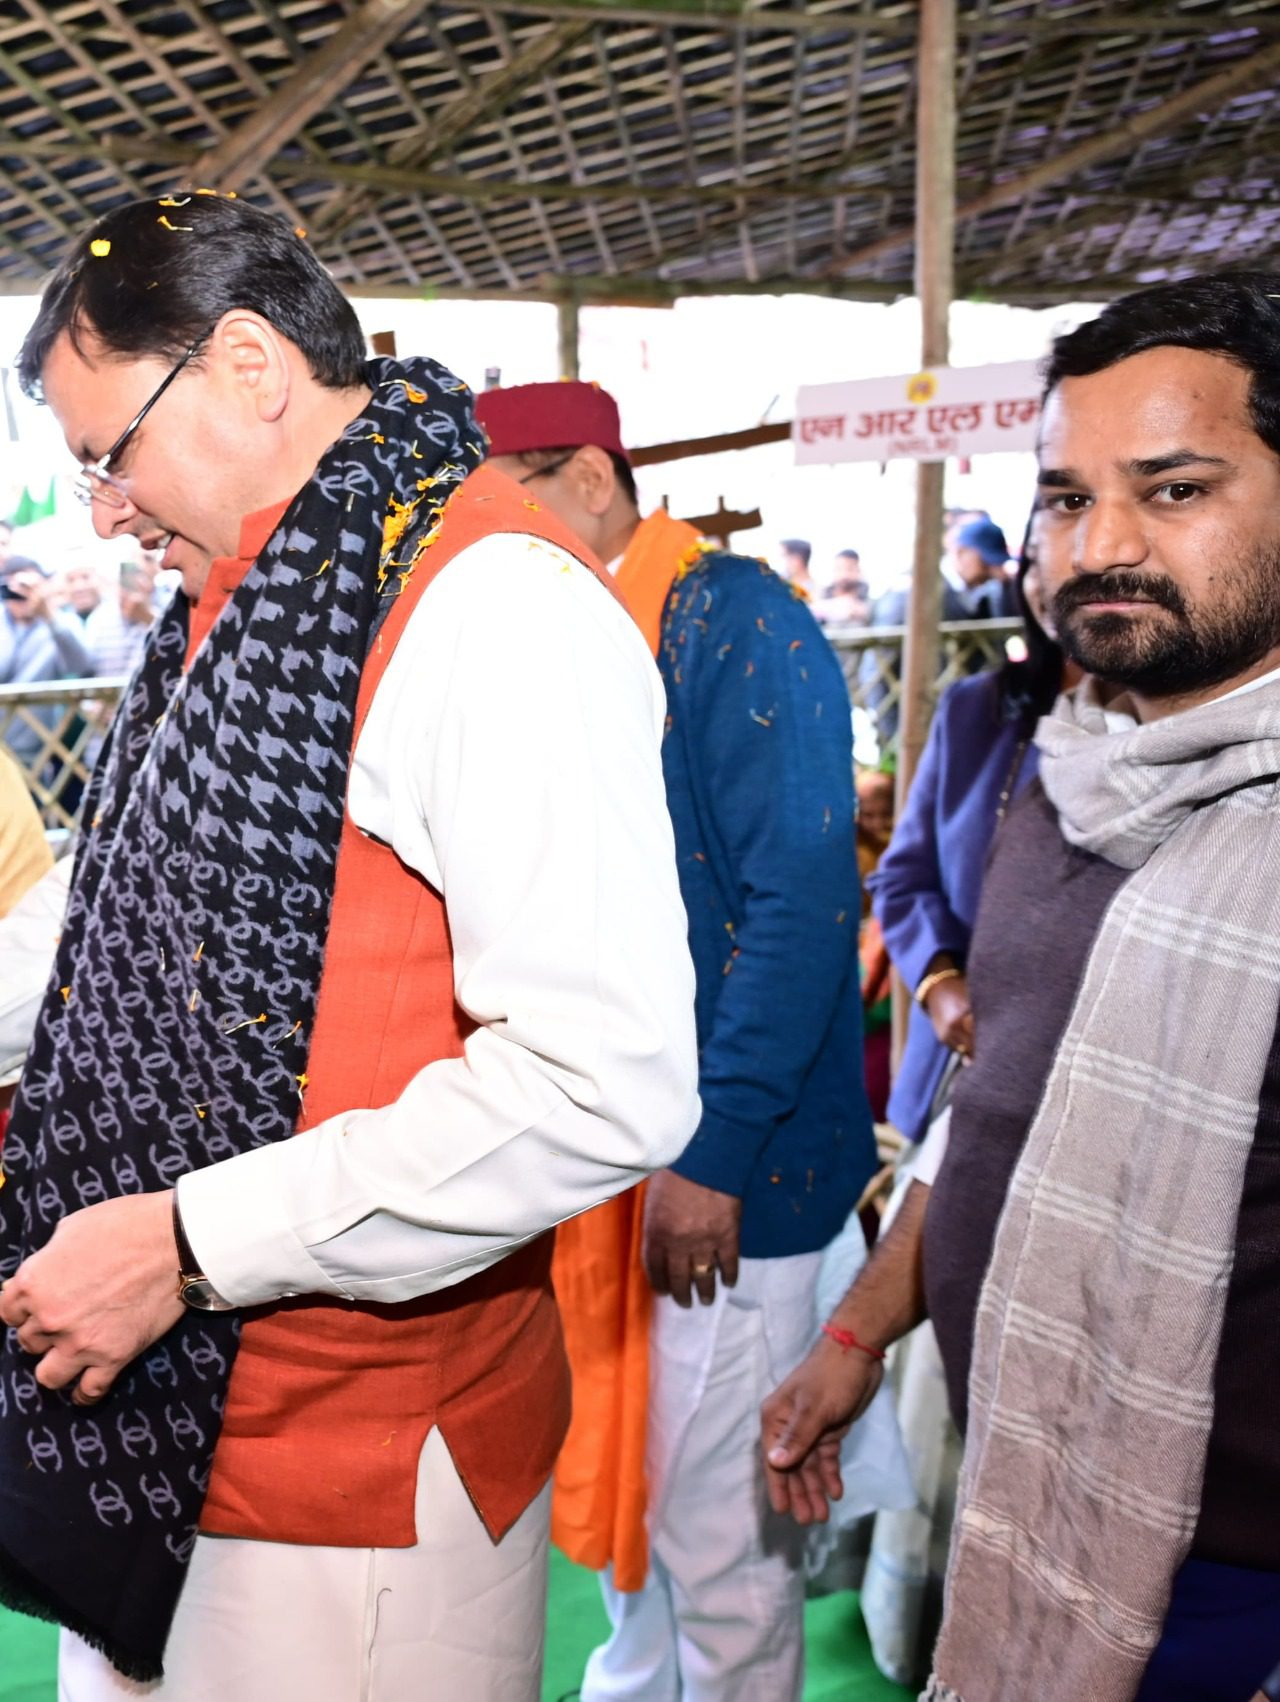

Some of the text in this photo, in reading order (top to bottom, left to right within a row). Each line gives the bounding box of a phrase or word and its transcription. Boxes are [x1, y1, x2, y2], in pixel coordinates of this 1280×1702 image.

[800, 416, 846, 443] एन
[856, 410, 918, 438] आर
[926, 403, 985, 433] एल
